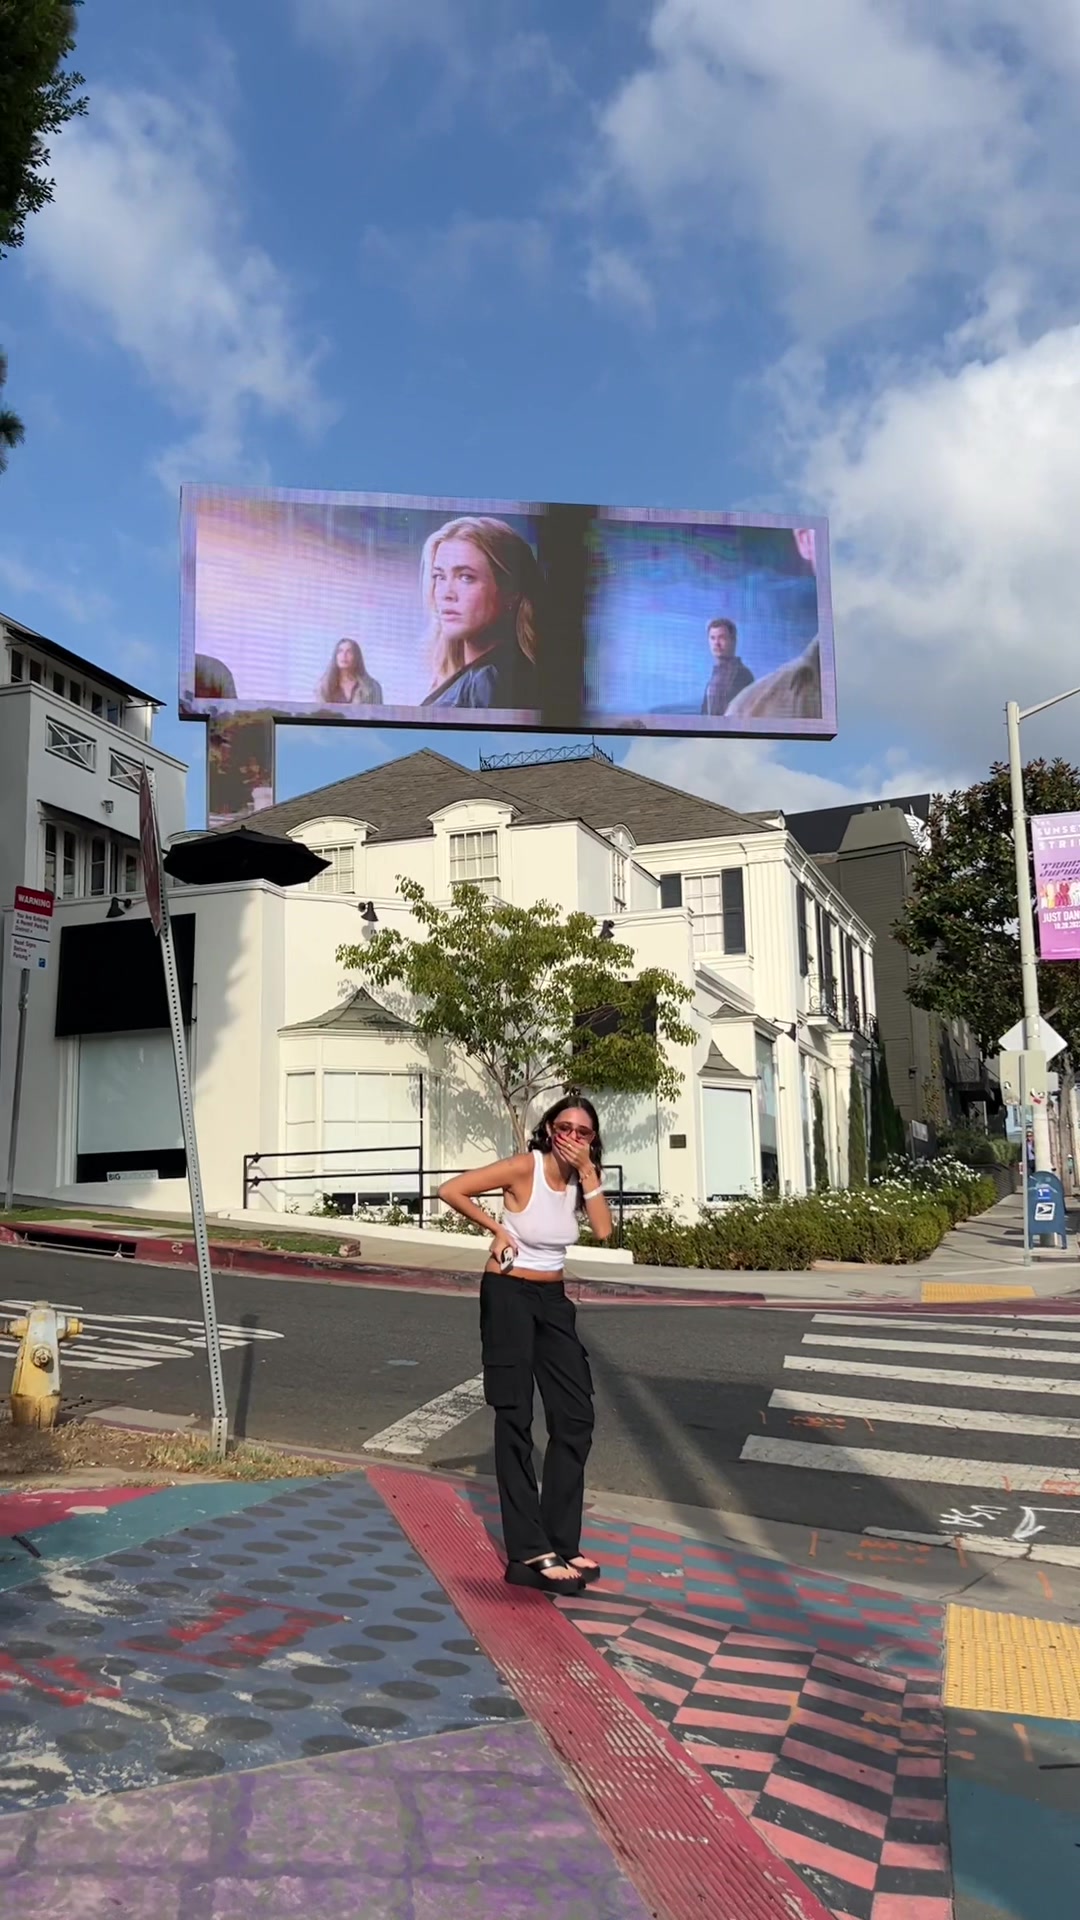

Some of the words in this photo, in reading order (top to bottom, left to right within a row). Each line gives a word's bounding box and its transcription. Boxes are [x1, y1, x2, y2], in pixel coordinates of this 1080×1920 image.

[18, 894, 51, 908] WARNING
[1042, 911, 1062, 924] JUST
[34, 922, 48, 932] Parking
[13, 952, 28, 961] Parking
